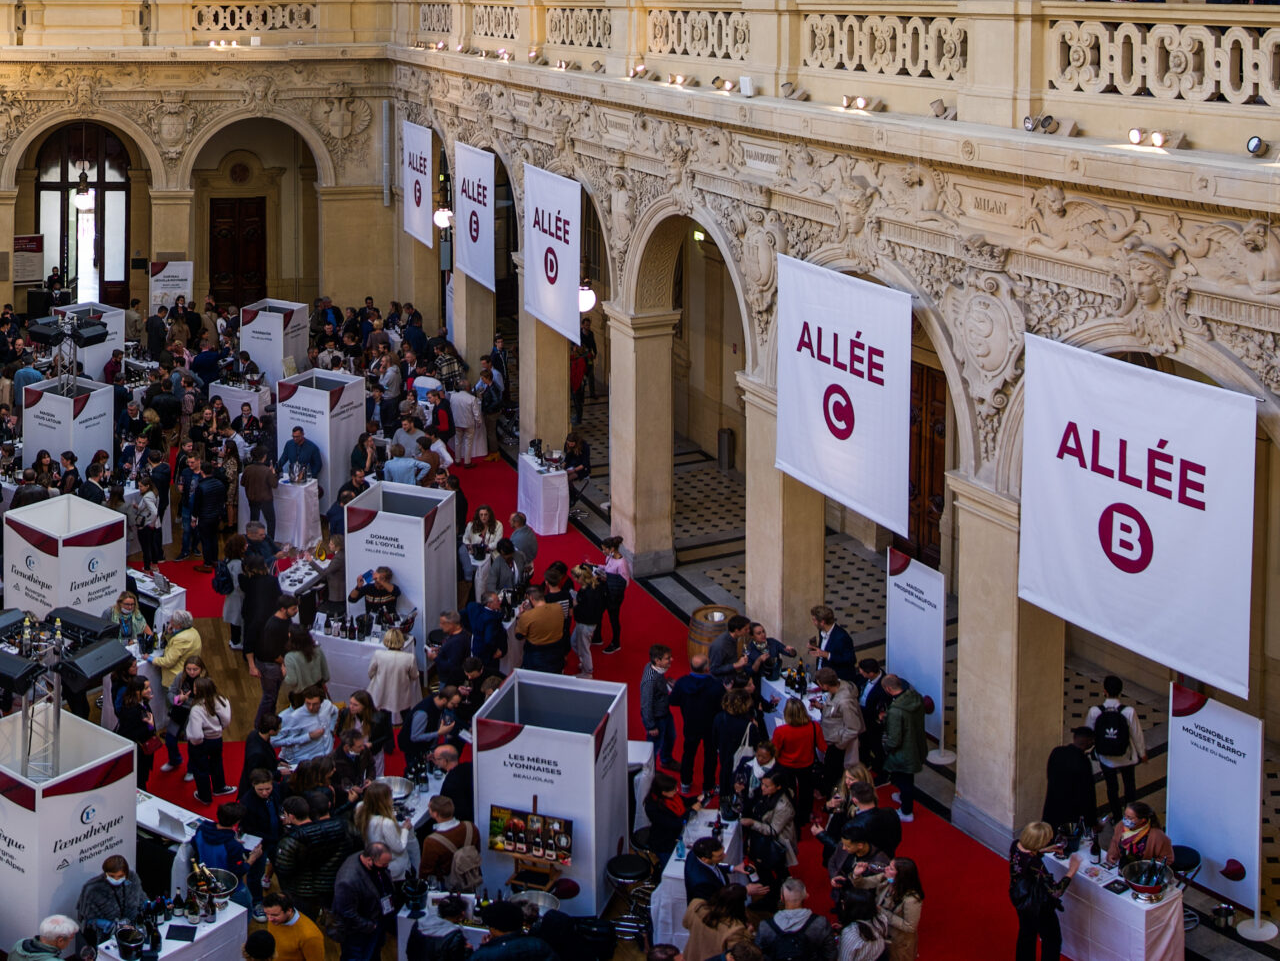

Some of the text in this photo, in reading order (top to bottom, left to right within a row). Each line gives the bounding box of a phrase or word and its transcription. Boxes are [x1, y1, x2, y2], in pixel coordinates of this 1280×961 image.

[408, 151, 427, 176] ALLÉE
[461, 177, 487, 207] ALLÉE
[973, 195, 1008, 216] MILAN
[533, 207, 570, 245] ALLÉE
[797, 322, 885, 386] ALLÉE
[1058, 422, 1206, 511] ALLÉE
[370, 533, 400, 543] DOMAINE
[1114, 514, 1141, 561] B
[1182, 725, 1247, 759] MOUSSET BARROT
[1194, 722, 1234, 745] VIGNOBLES
[503, 760, 562, 776] LYONNAISES
[508, 753, 525, 762] LES
[78, 839, 124, 864] Rhône-Alpes
[79, 836, 116, 855] Auvergne-
